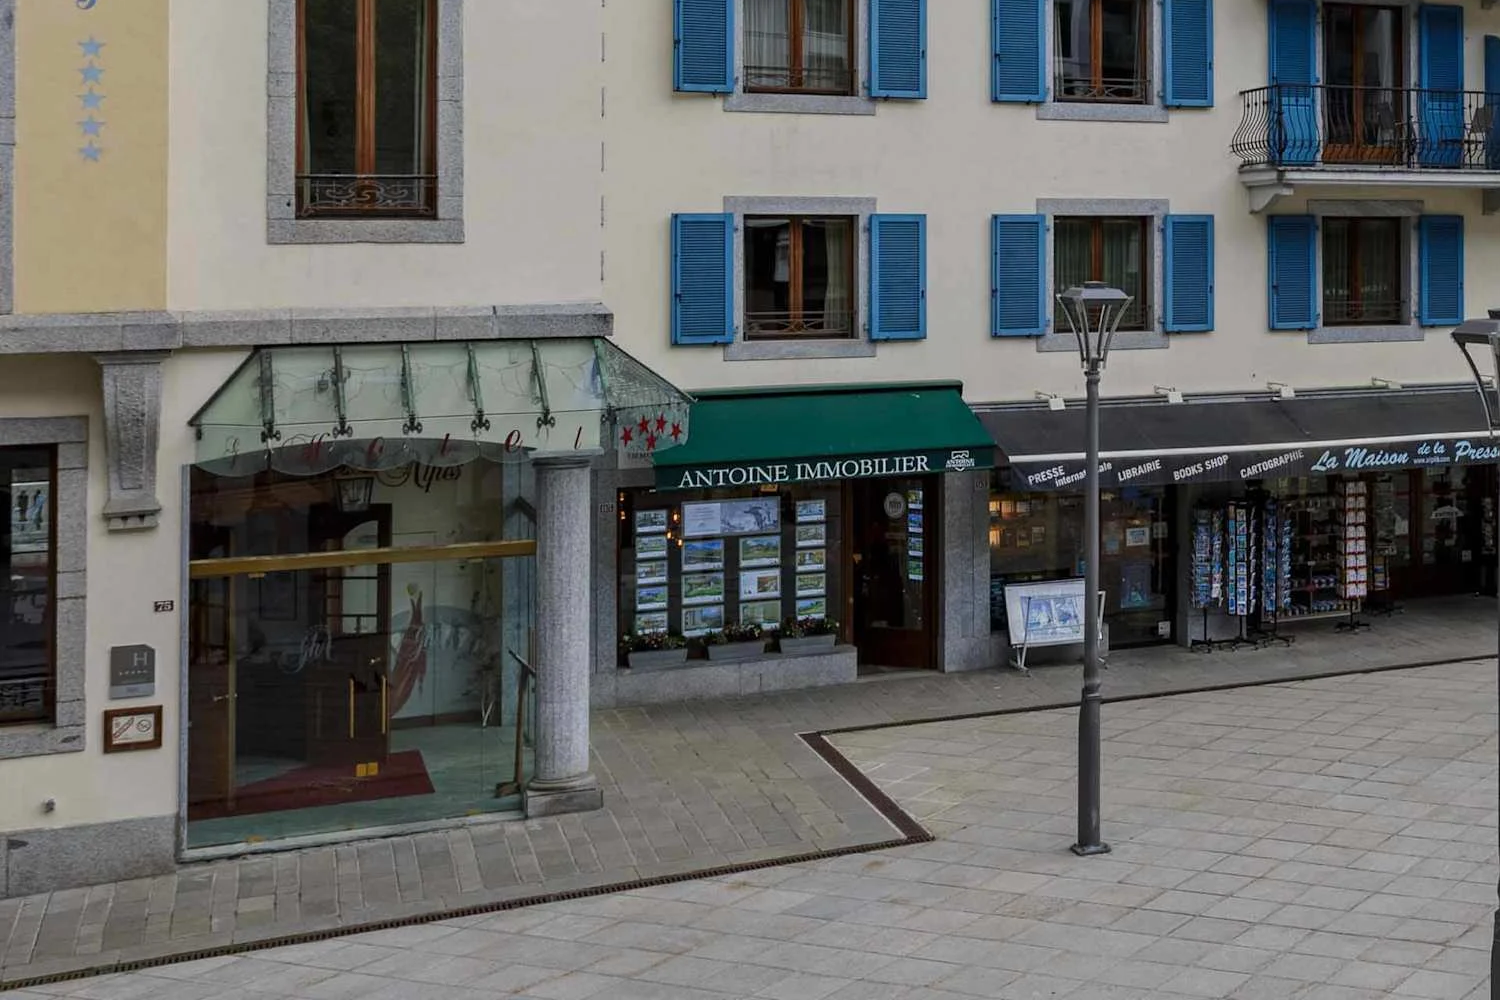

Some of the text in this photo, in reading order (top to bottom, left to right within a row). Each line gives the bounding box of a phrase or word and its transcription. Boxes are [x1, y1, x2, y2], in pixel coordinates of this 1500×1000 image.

[1173, 454, 1229, 481] BOOKS SHOP
[1239, 449, 1304, 479] CARTOGRAPHIE
[1311, 450, 1338, 472] La
[1344, 447, 1409, 469] Maison
[1417, 441, 1431, 455] de
[1433, 441, 1446, 454] la
[1455, 440, 1500, 462] Press
[678, 455, 930, 488] ANTOINE IMMOBILIER
[1028, 465, 1065, 486] PRESSE
[1118, 459, 1162, 482] LIBRAIRIE
[157, 601, 172, 611] 75
[134, 652, 147, 666] H
